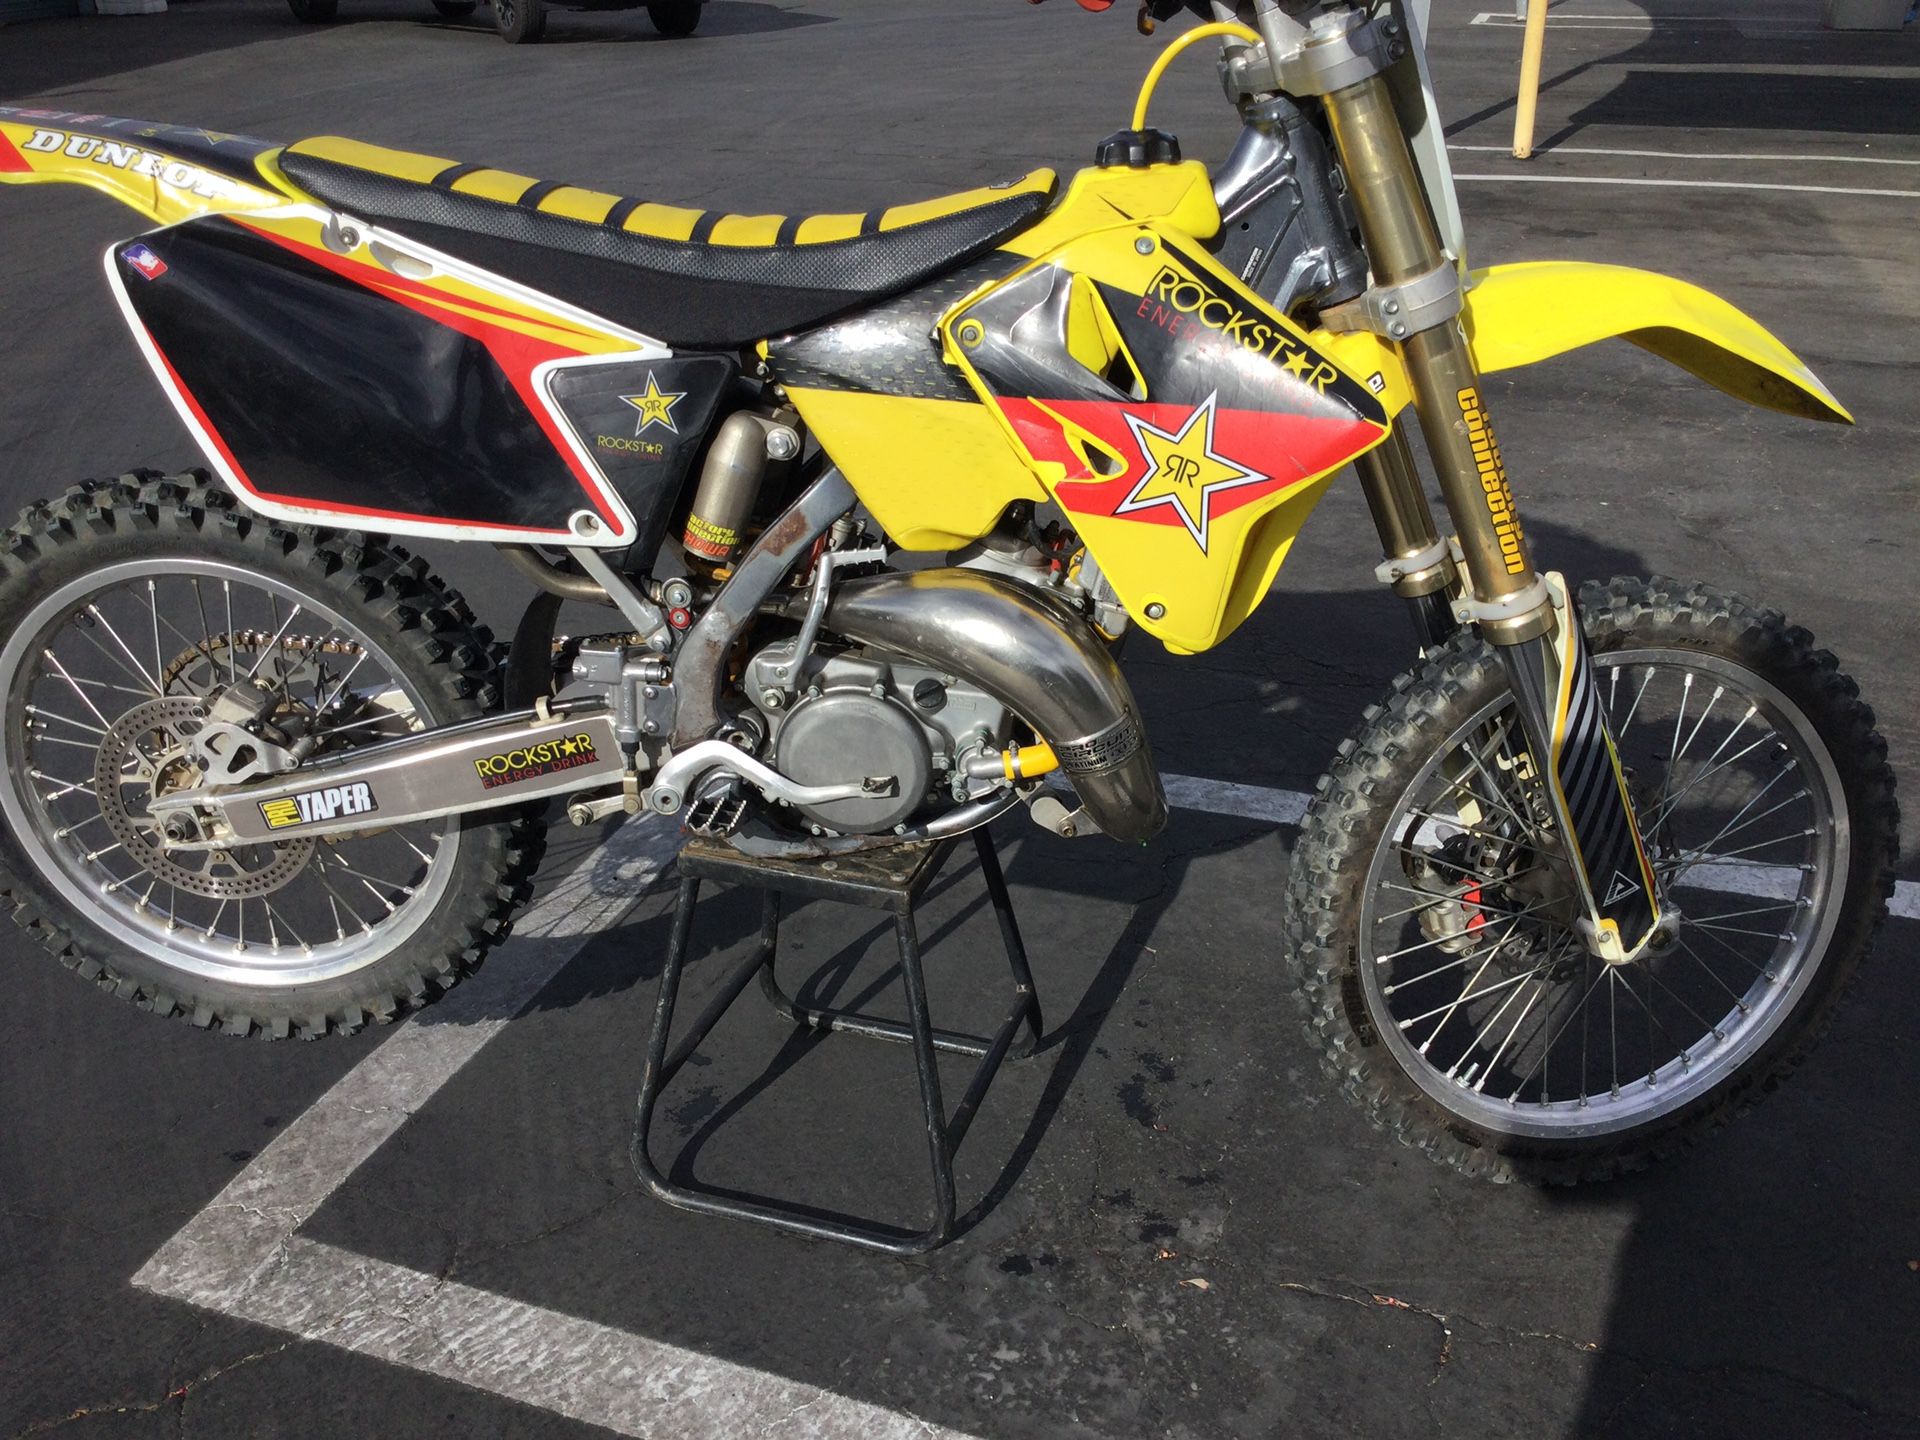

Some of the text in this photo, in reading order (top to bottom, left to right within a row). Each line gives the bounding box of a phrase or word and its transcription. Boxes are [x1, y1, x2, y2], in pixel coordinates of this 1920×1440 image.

[482, 752, 597, 789] ENERGY DRINK
[262, 782, 372, 827] PRO TAPER
